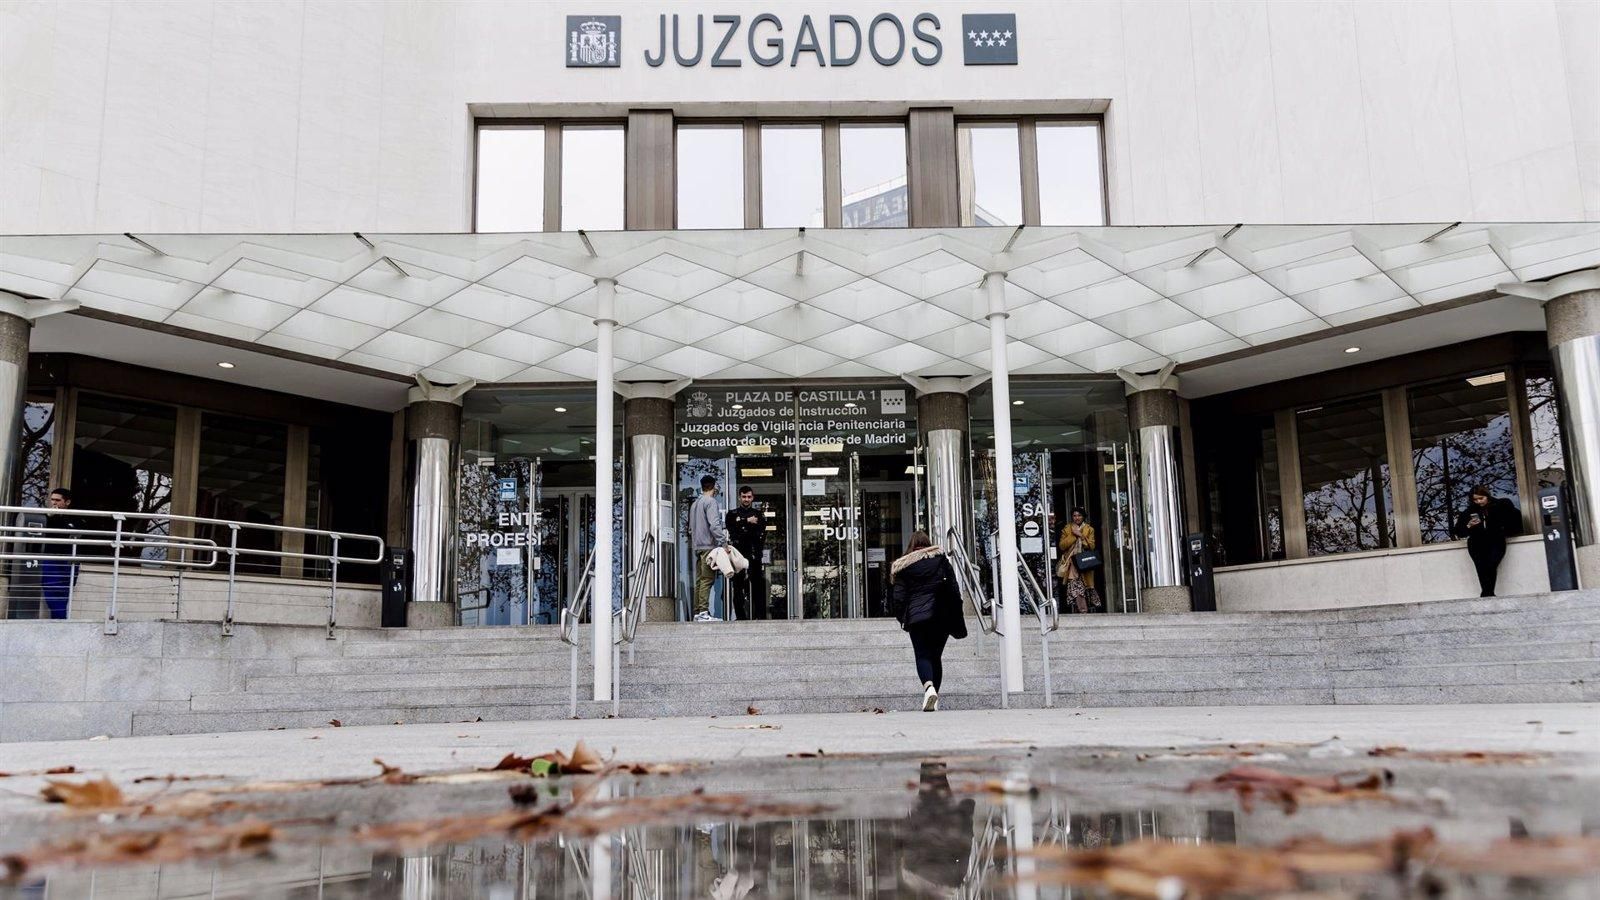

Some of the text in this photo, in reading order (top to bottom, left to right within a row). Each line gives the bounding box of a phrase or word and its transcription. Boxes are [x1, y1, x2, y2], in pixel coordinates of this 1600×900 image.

[644, 12, 943, 68] JUZGADOS
[725, 390, 876, 403] PLAZA DE CASTILLA 1
[717, 406, 776, 420] Juzgados
[779, 406, 794, 416] de
[681, 418, 906, 435] Juzgados de Vigilancia Penitenciaria
[681, 432, 906, 449] Decanato de los Juzgados de Madrid
[1022, 502, 1055, 517] SAL
[466, 532, 542, 547] PROFESI
[824, 523, 862, 541] PÚB
